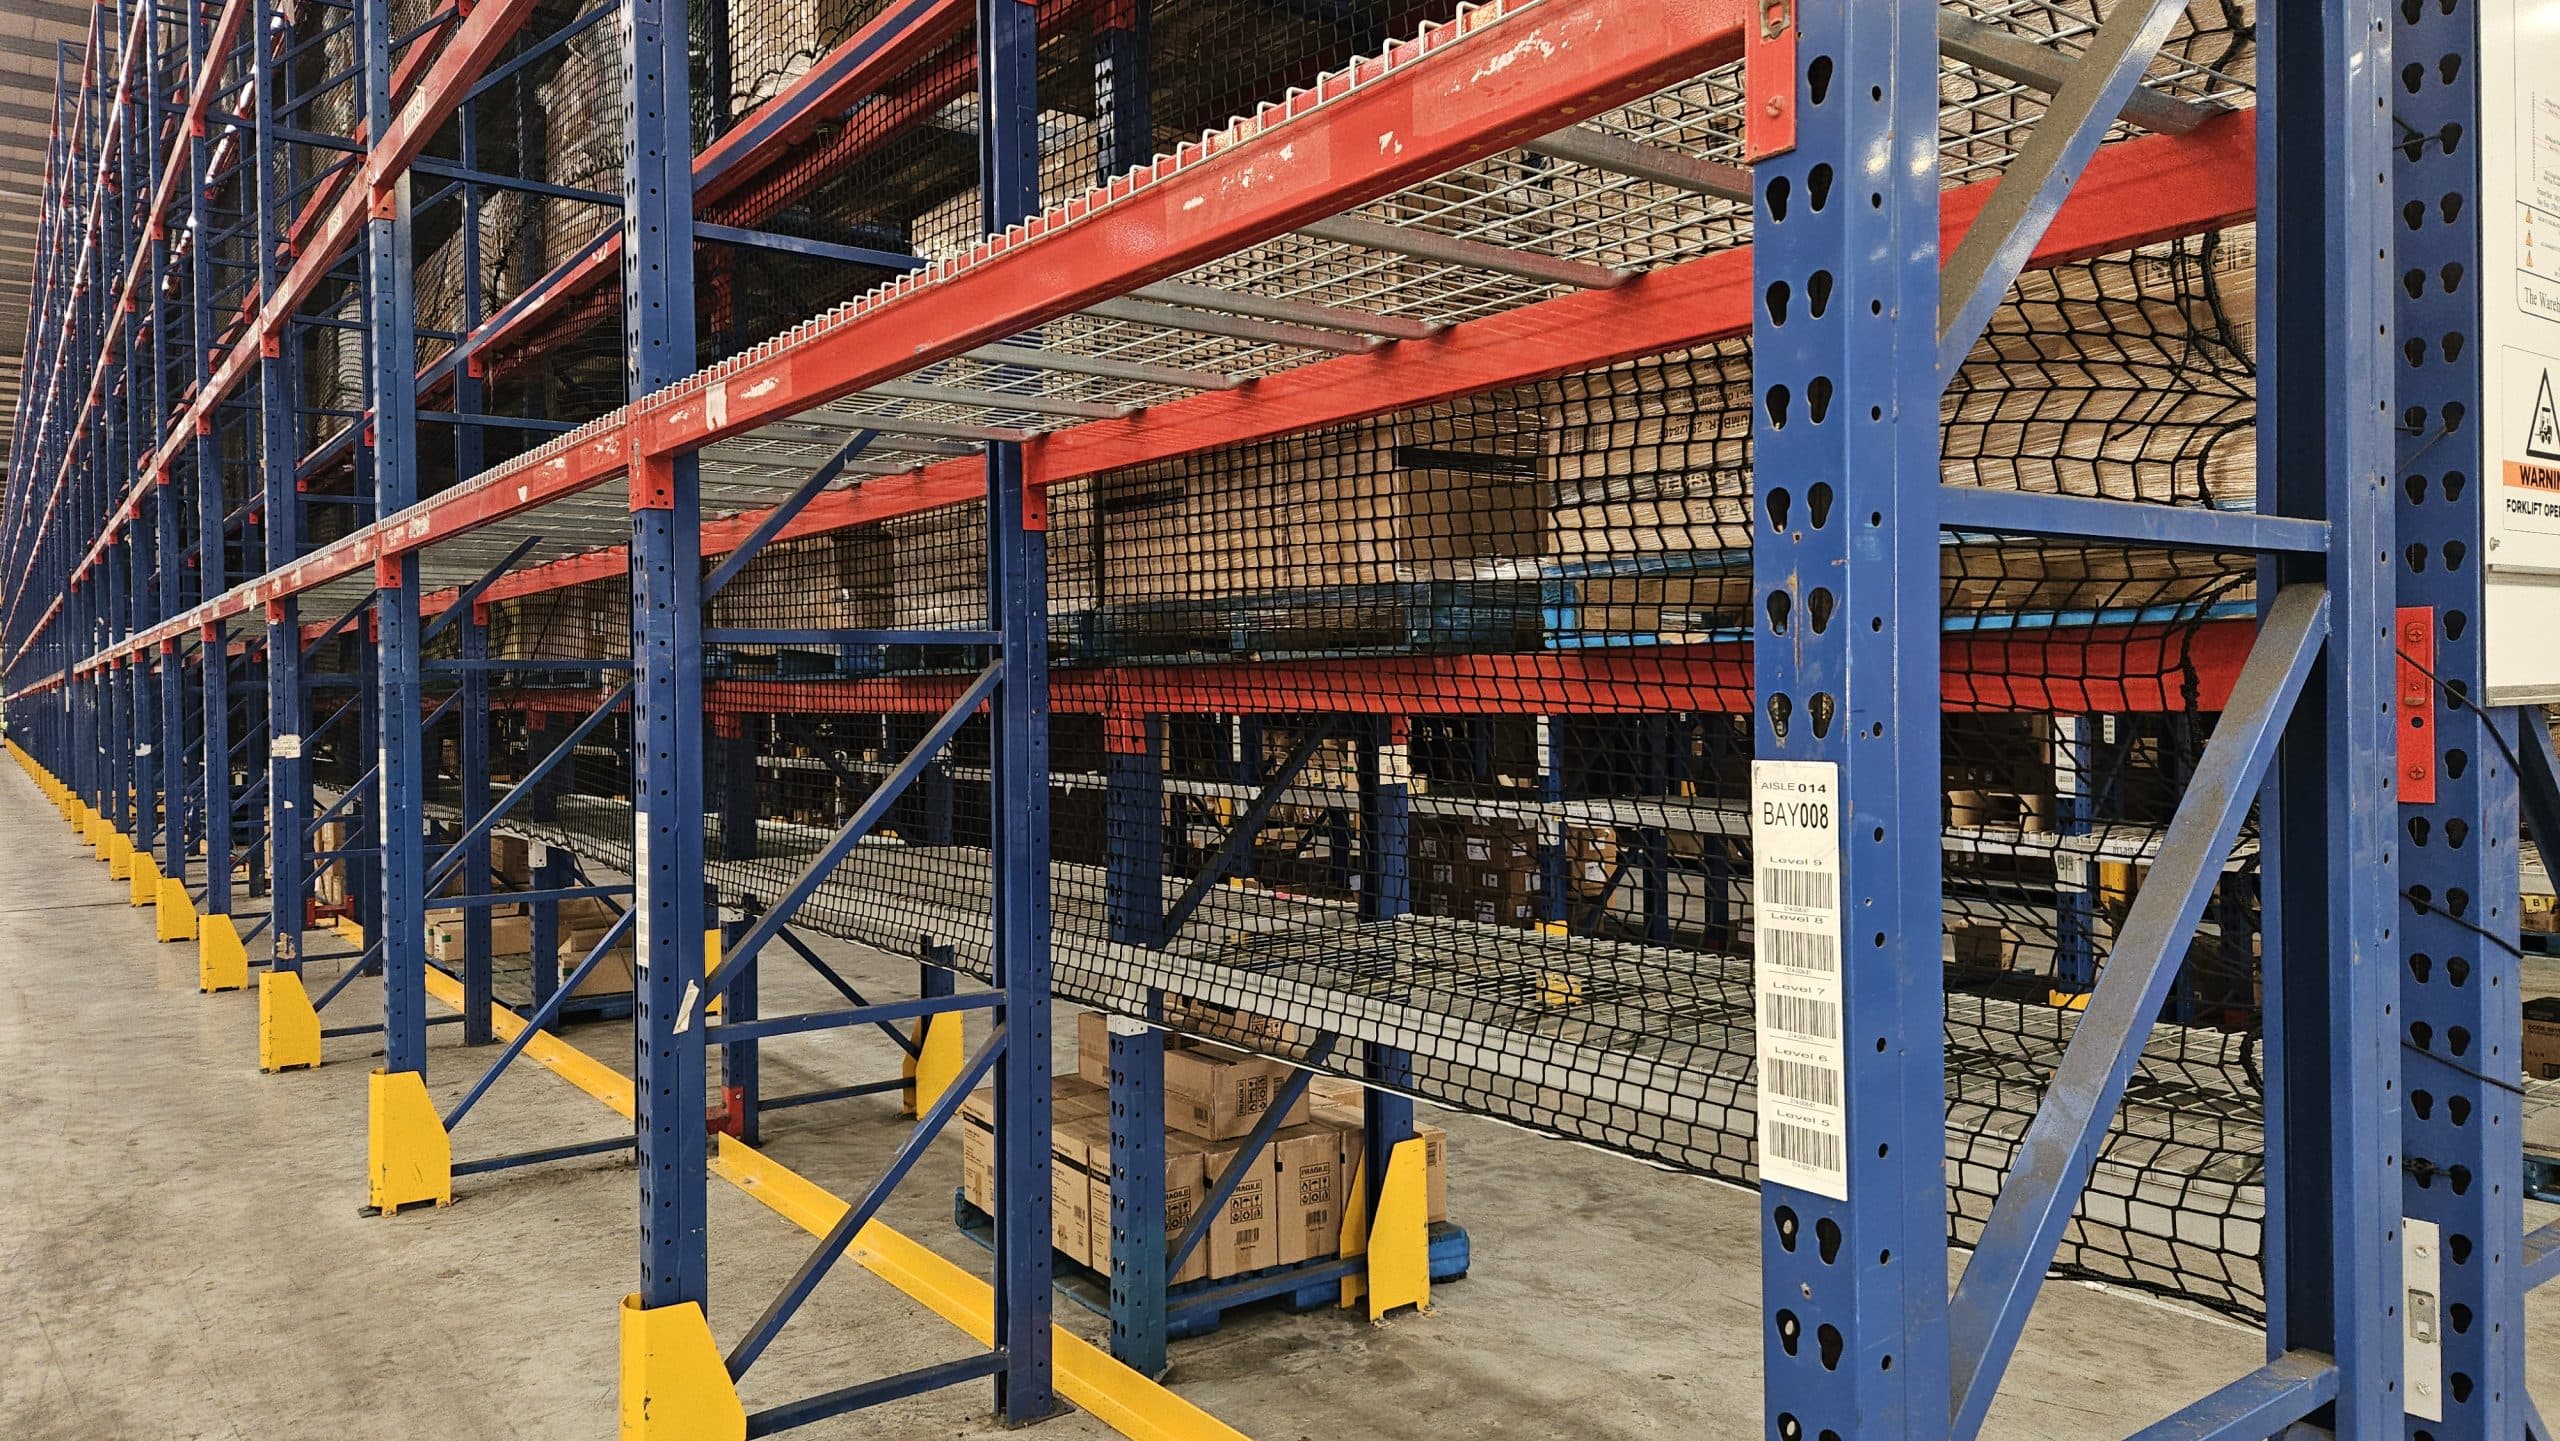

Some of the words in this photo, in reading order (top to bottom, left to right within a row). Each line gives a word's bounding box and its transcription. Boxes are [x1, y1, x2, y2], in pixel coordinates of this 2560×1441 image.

[2524, 286, 2537, 306] The
[2506, 498, 2542, 516] FORKLIFT
[2544, 503, 2560, 518] OPE
[1761, 782, 1796, 791] AISLE
[1798, 783, 1826, 793] 014
[1764, 801, 1829, 829] BAY008
[1770, 856, 1808, 866] Level
[1813, 859, 1822, 867] 9
[1771, 913, 1809, 924] Level
[1814, 917, 1823, 925] 8
[1773, 981, 1812, 994] Level
[1775, 1046, 1814, 1060] Level
[1818, 1054, 1828, 1062] 6
[1777, 1108, 1816, 1124] Level
[1821, 1119, 1830, 1127] 5
[1301, 1164, 1329, 1177] FRAGILE
[1165, 1188, 1189, 1201] RAGILE
[1236, 1182, 1261, 1194] RAGILE
